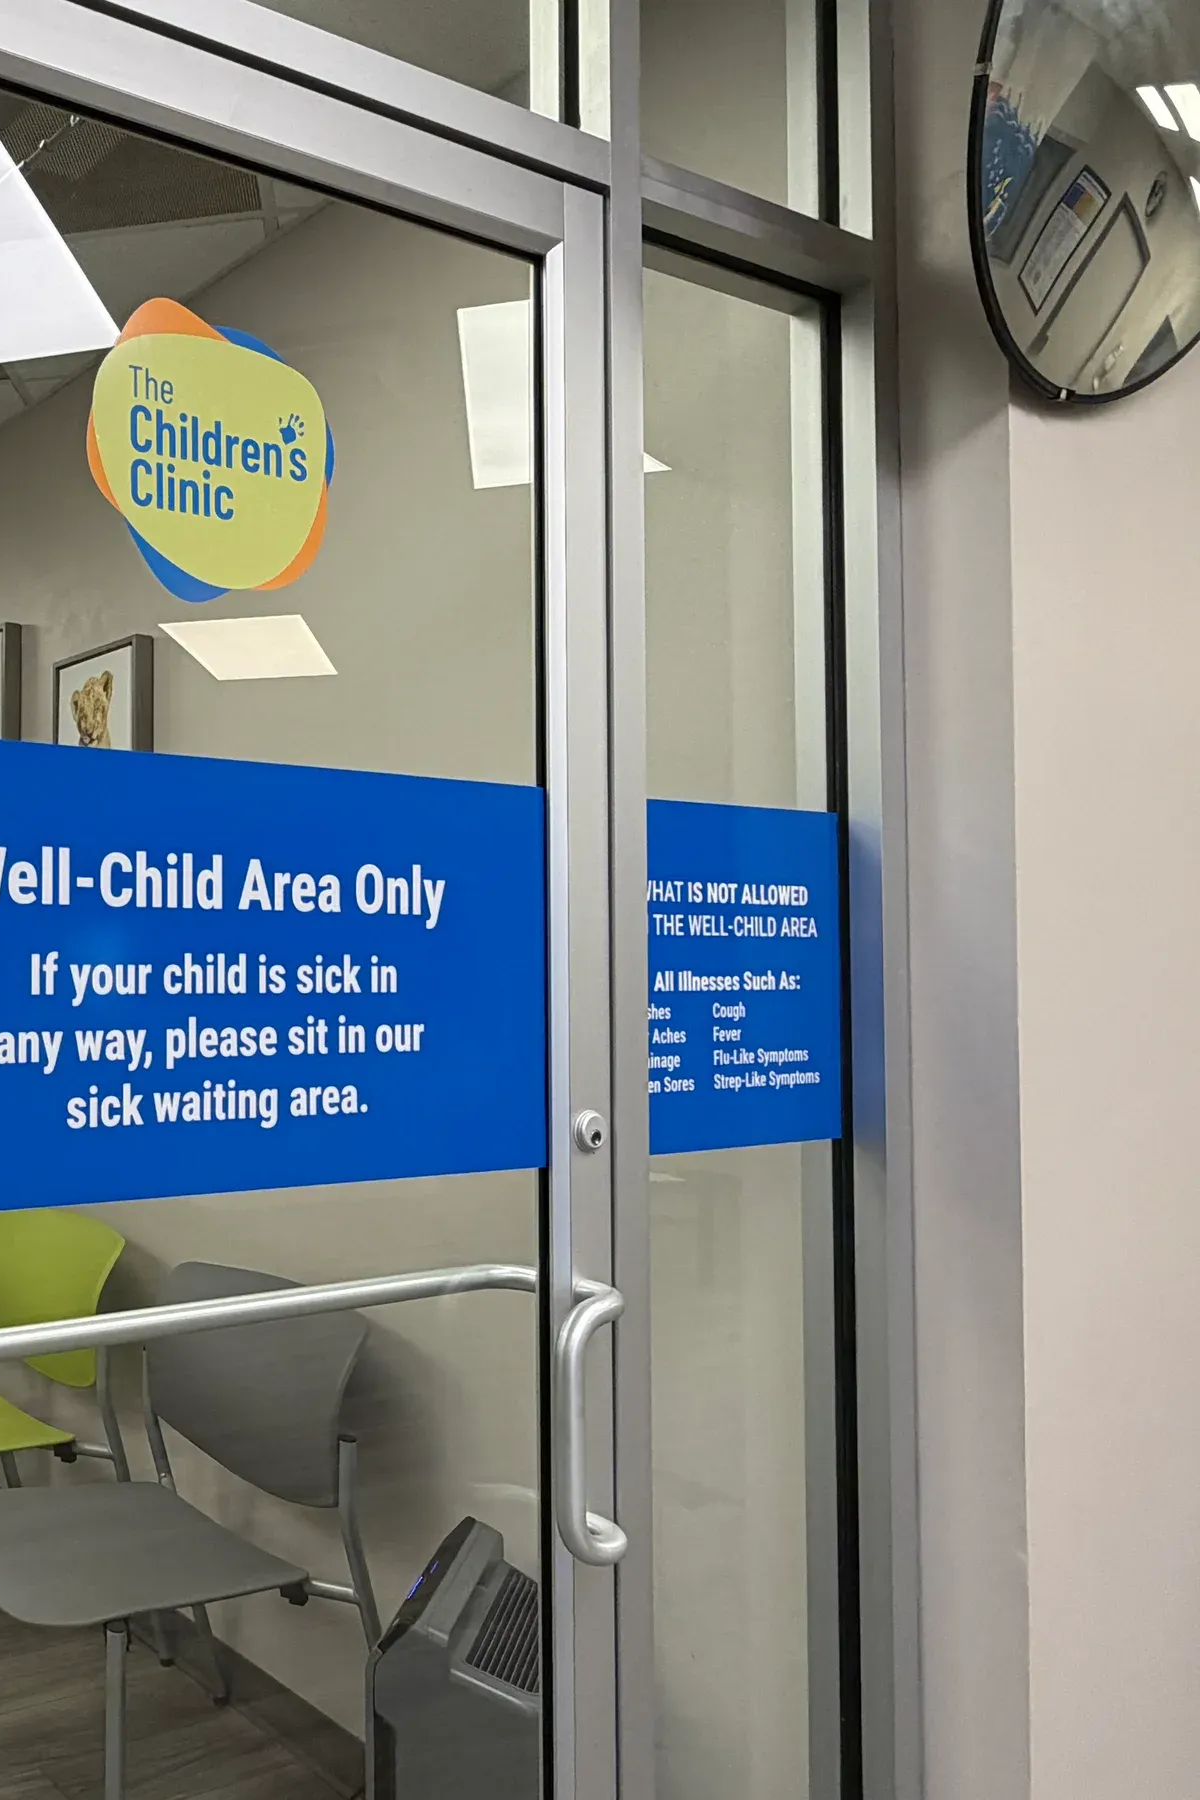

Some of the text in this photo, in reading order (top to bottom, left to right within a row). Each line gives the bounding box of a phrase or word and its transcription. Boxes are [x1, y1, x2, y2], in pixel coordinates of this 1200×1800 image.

[129, 365, 173, 405] The
[130, 459, 234, 520] Clinic
[239, 859, 341, 912] Area
[356, 864, 445, 929] Only
[688, 882, 703, 903] IS
[707, 883, 738, 903] NOT
[741, 884, 808, 905] ALLOWED
[653, 914, 684, 935] THE
[689, 915, 776, 937] WELL-CHILD
[781, 917, 817, 937] AREA
[32, 952, 397, 1006] If your child is sick in
[654, 970, 800, 991] All Illnesses Such As:
[713, 1002, 745, 1021] Cough
[75, 1030, 152, 1071] way,
[166, 1017, 277, 1069] please
[288, 1016, 328, 1055] sit
[339, 1015, 365, 1053] in
[376, 1024, 424, 1052] our
[653, 1028, 686, 1043] Aches
[714, 1027, 741, 1041] Fever
[714, 1049, 808, 1066] Flu-Like Symptoms
[664, 1077, 694, 1092] Sores
[714, 1071, 820, 1091] Strep-Like Symptoms
[67, 1080, 367, 1128] sick waiting area.
